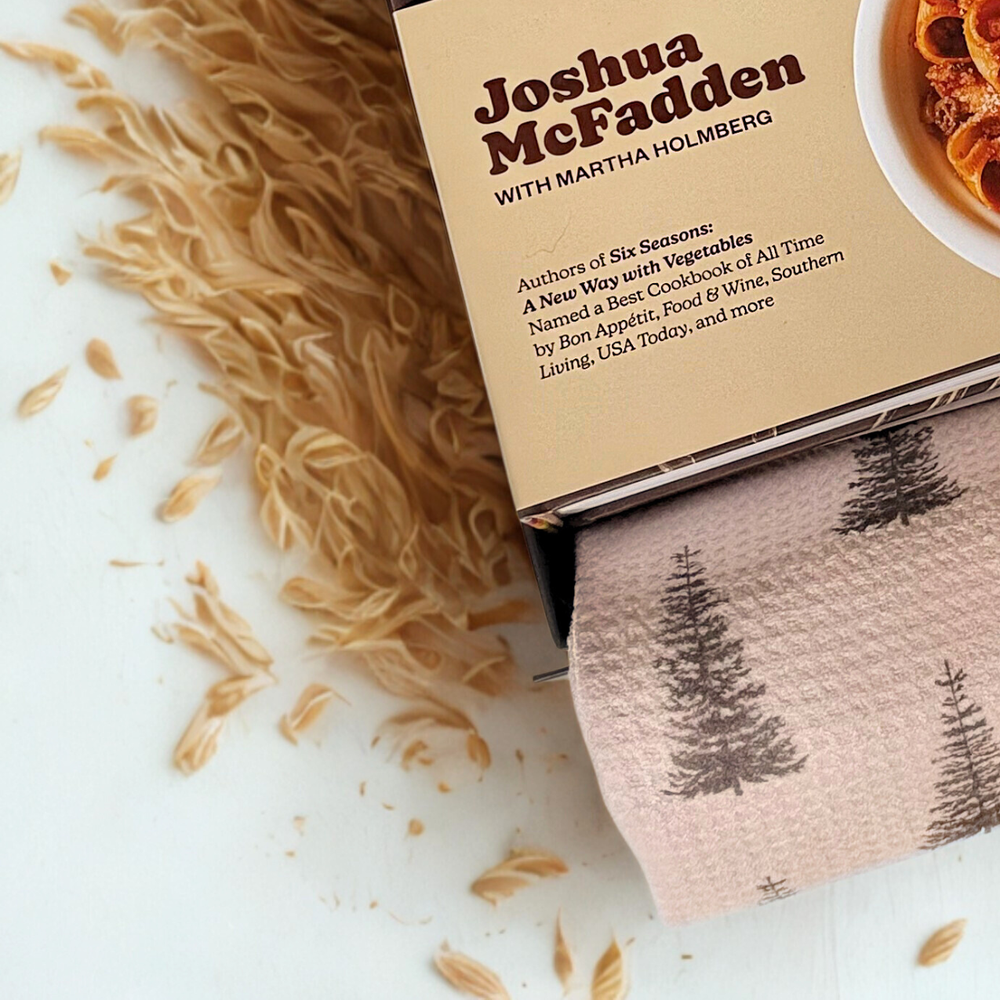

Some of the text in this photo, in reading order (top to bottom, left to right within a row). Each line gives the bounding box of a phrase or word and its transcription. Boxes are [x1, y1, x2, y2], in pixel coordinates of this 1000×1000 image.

[474, 33, 703, 125] Joshua
[482, 54, 805, 176] McFadden
[494, 110, 773, 206] WITH MARTHA HOLMBERG
[517, 223, 714, 293] Authors of Six Seasons:
[523, 233, 754, 315] A New Way with Vegetables
[528, 234, 825, 336] Named a Best Cookbook of All Time
[533, 251, 845, 357] by Bon Appétit, Food & Wine, Southern
[539, 296, 775, 380] Living, USA Today, and more
